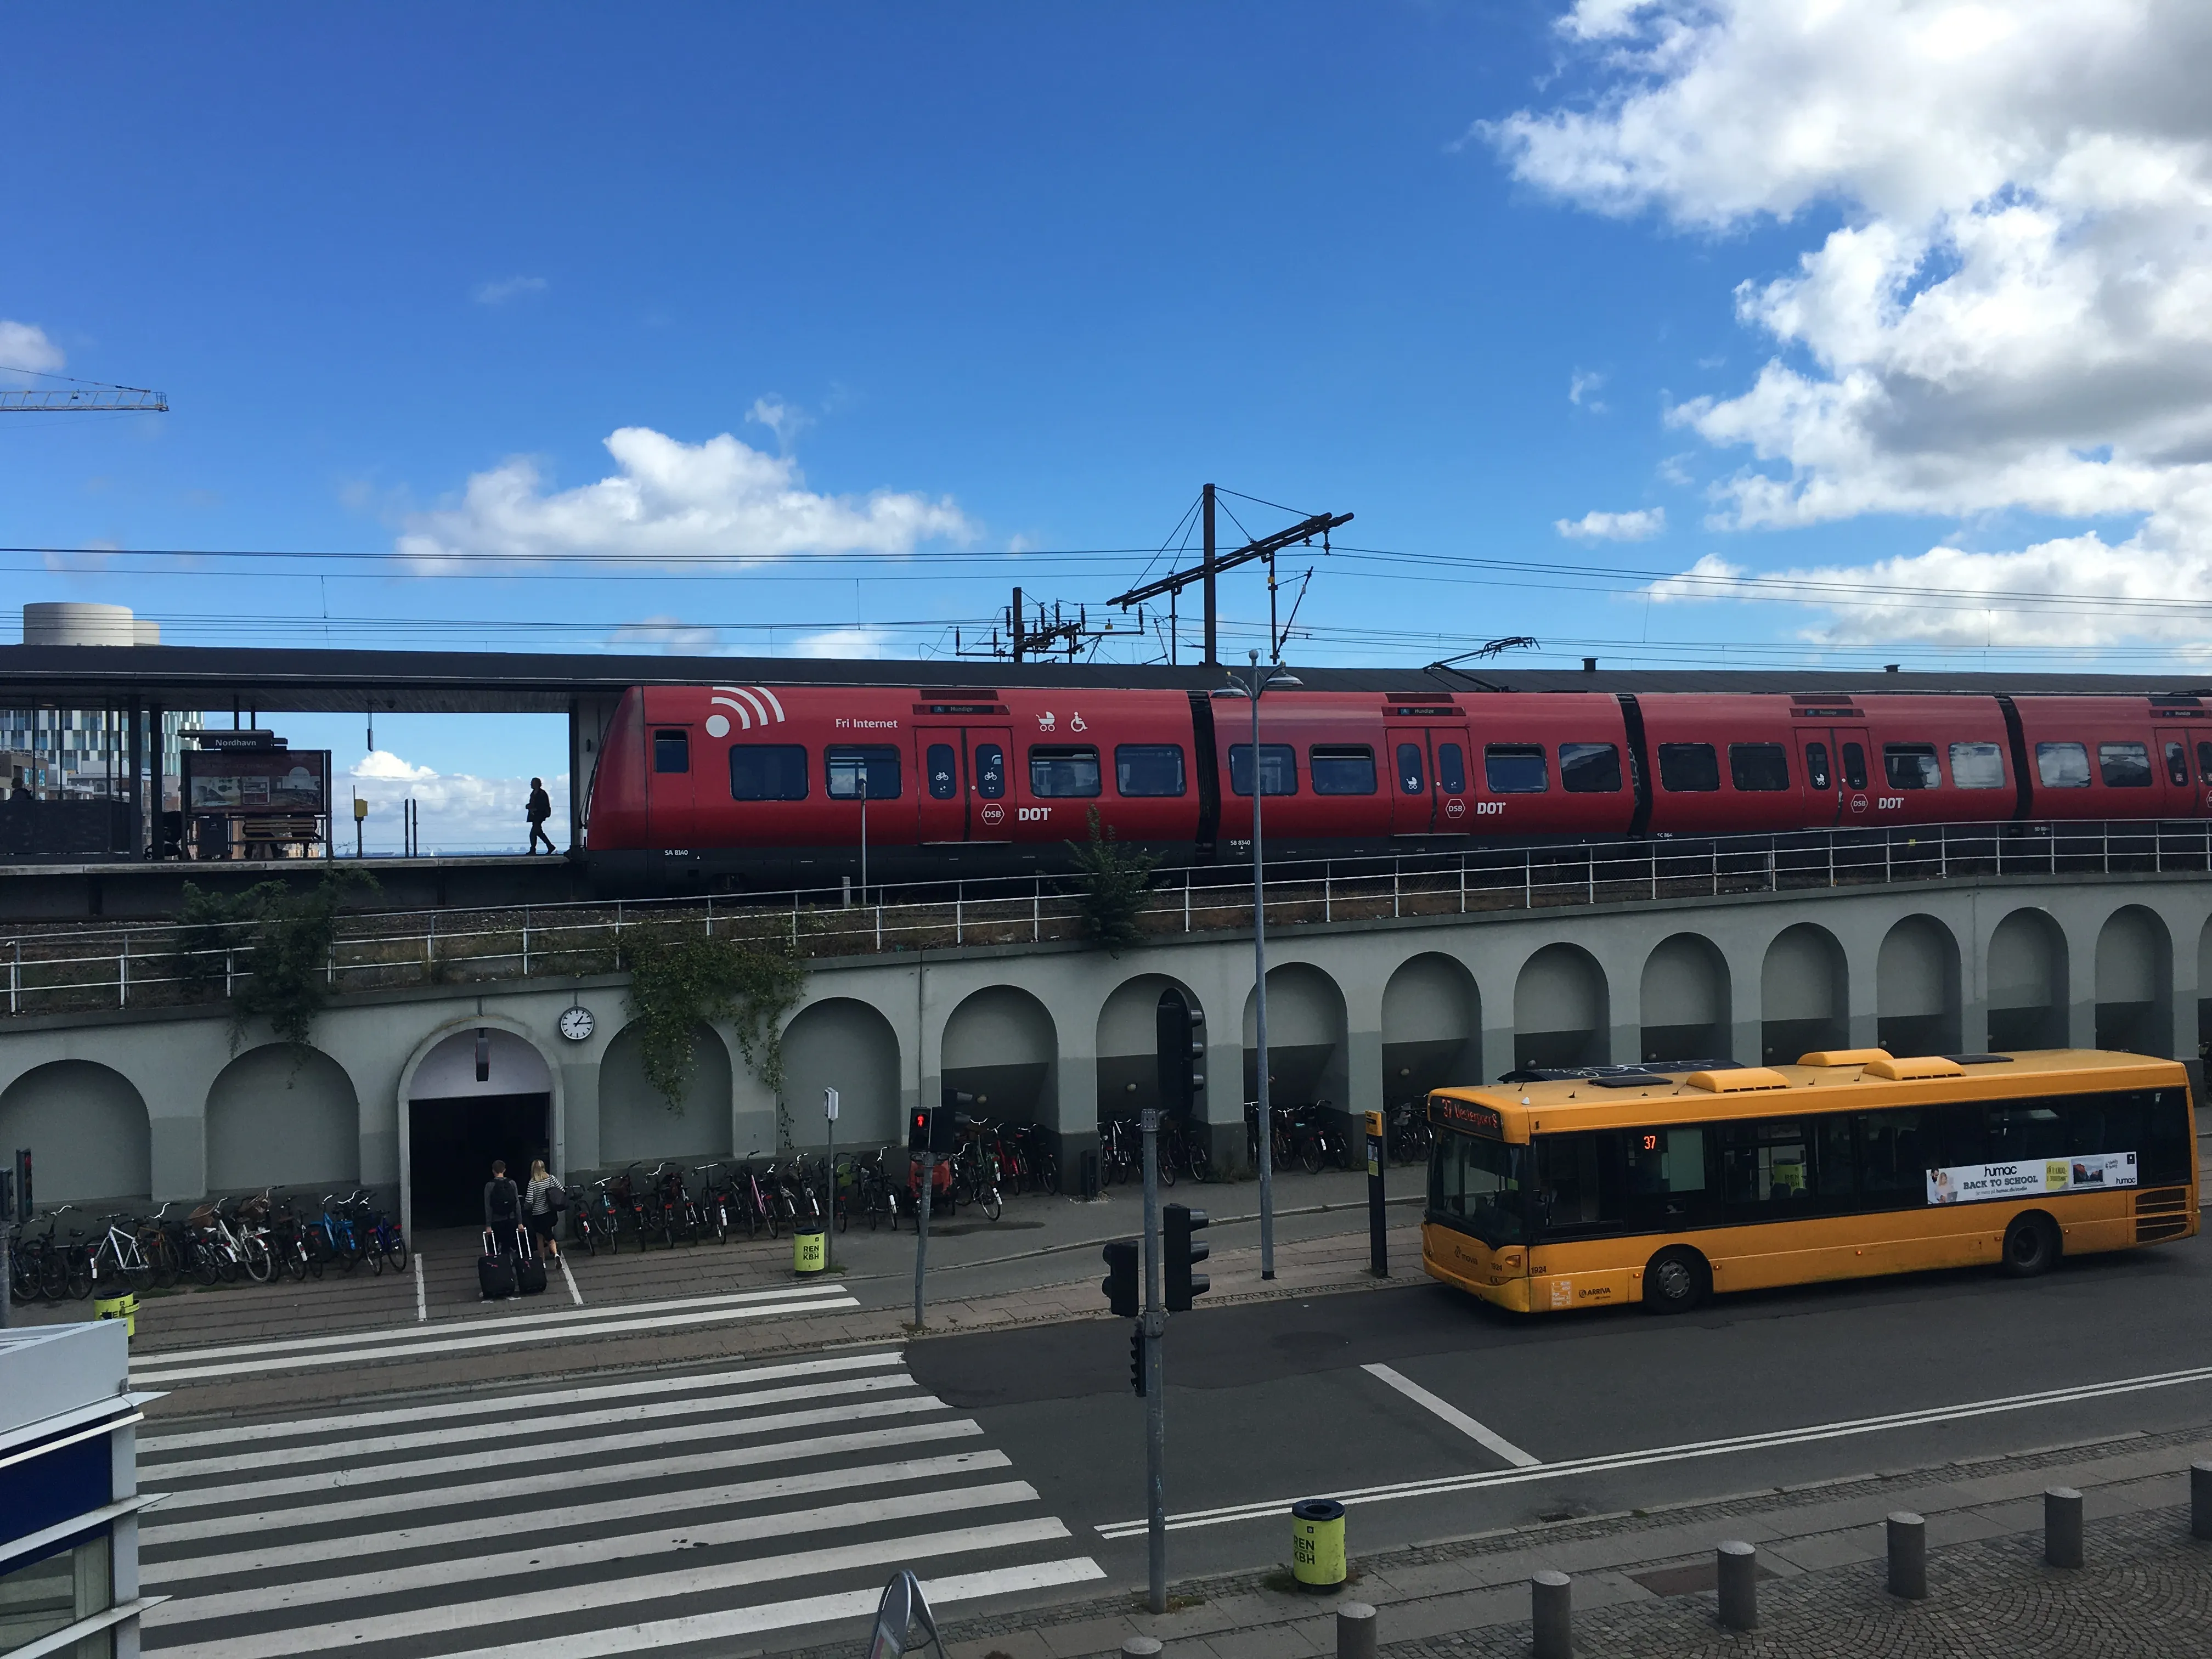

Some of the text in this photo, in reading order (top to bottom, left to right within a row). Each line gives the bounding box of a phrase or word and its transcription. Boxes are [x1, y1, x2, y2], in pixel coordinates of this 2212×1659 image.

[836, 719, 898, 728] Fri Internet
[1477, 802, 1506, 815] DOT
[1878, 797, 1904, 809] DOT
[1019, 808, 1052, 821] DOT
[1441, 1098, 1452, 1119] 37
[1644, 1136, 1656, 1149] 37
[1984, 1166, 2017, 1177] humac
[1963, 1180, 1988, 1190] BACK
[1990, 1179, 2002, 1187] TO
[2004, 1175, 2039, 1186] SCHOOL
[1491, 1262, 1502, 1271] 1924
[1531, 1266, 1547, 1274] 1924
[1587, 1287, 1611, 1295] ARRIVA
[1294, 1534, 1314, 1550] REN
[1294, 1549, 1315, 1565] KBH
